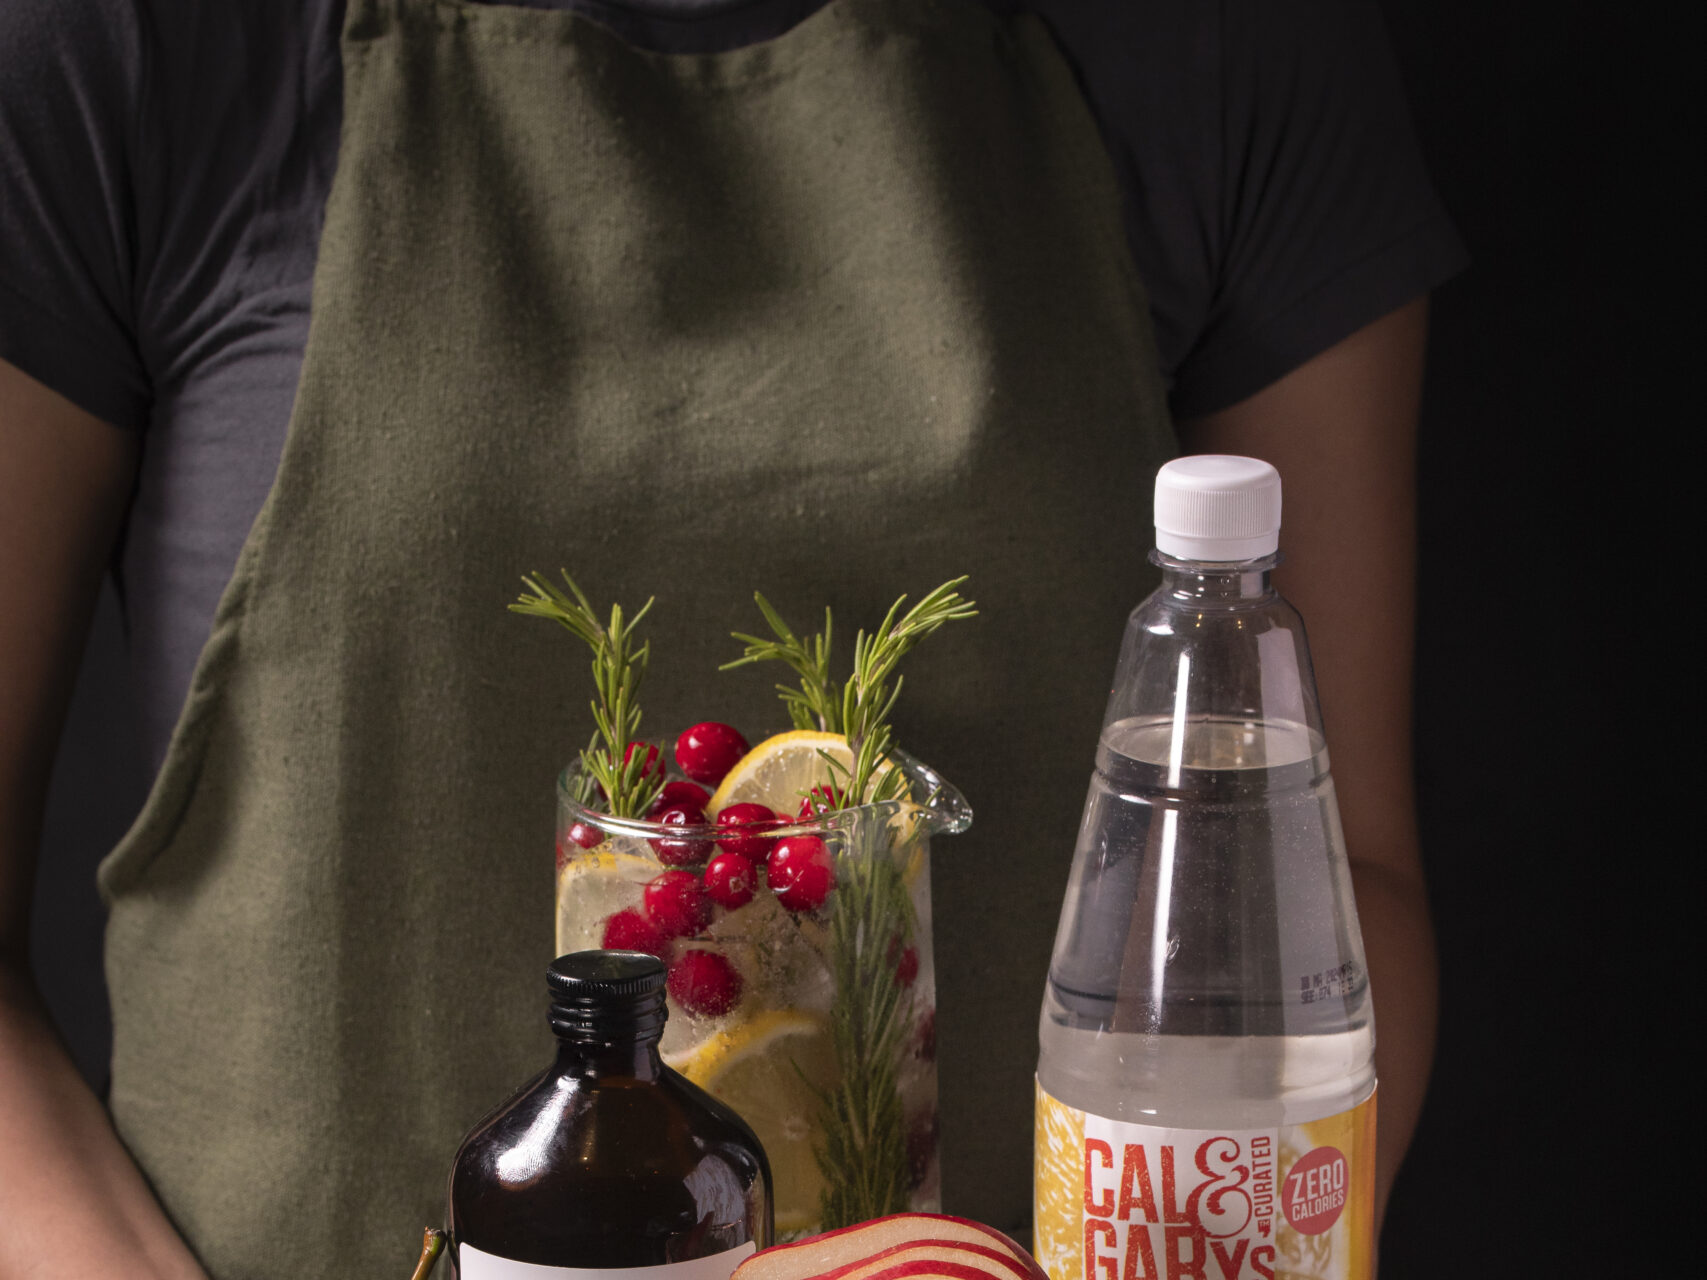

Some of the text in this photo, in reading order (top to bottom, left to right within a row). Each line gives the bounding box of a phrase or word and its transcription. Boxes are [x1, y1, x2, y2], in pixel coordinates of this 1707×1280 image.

[1251, 1136, 1273, 1217] CURATED
[1290, 1158, 1344, 1205] ZERO
[1292, 1189, 1344, 1222] CALORIES
